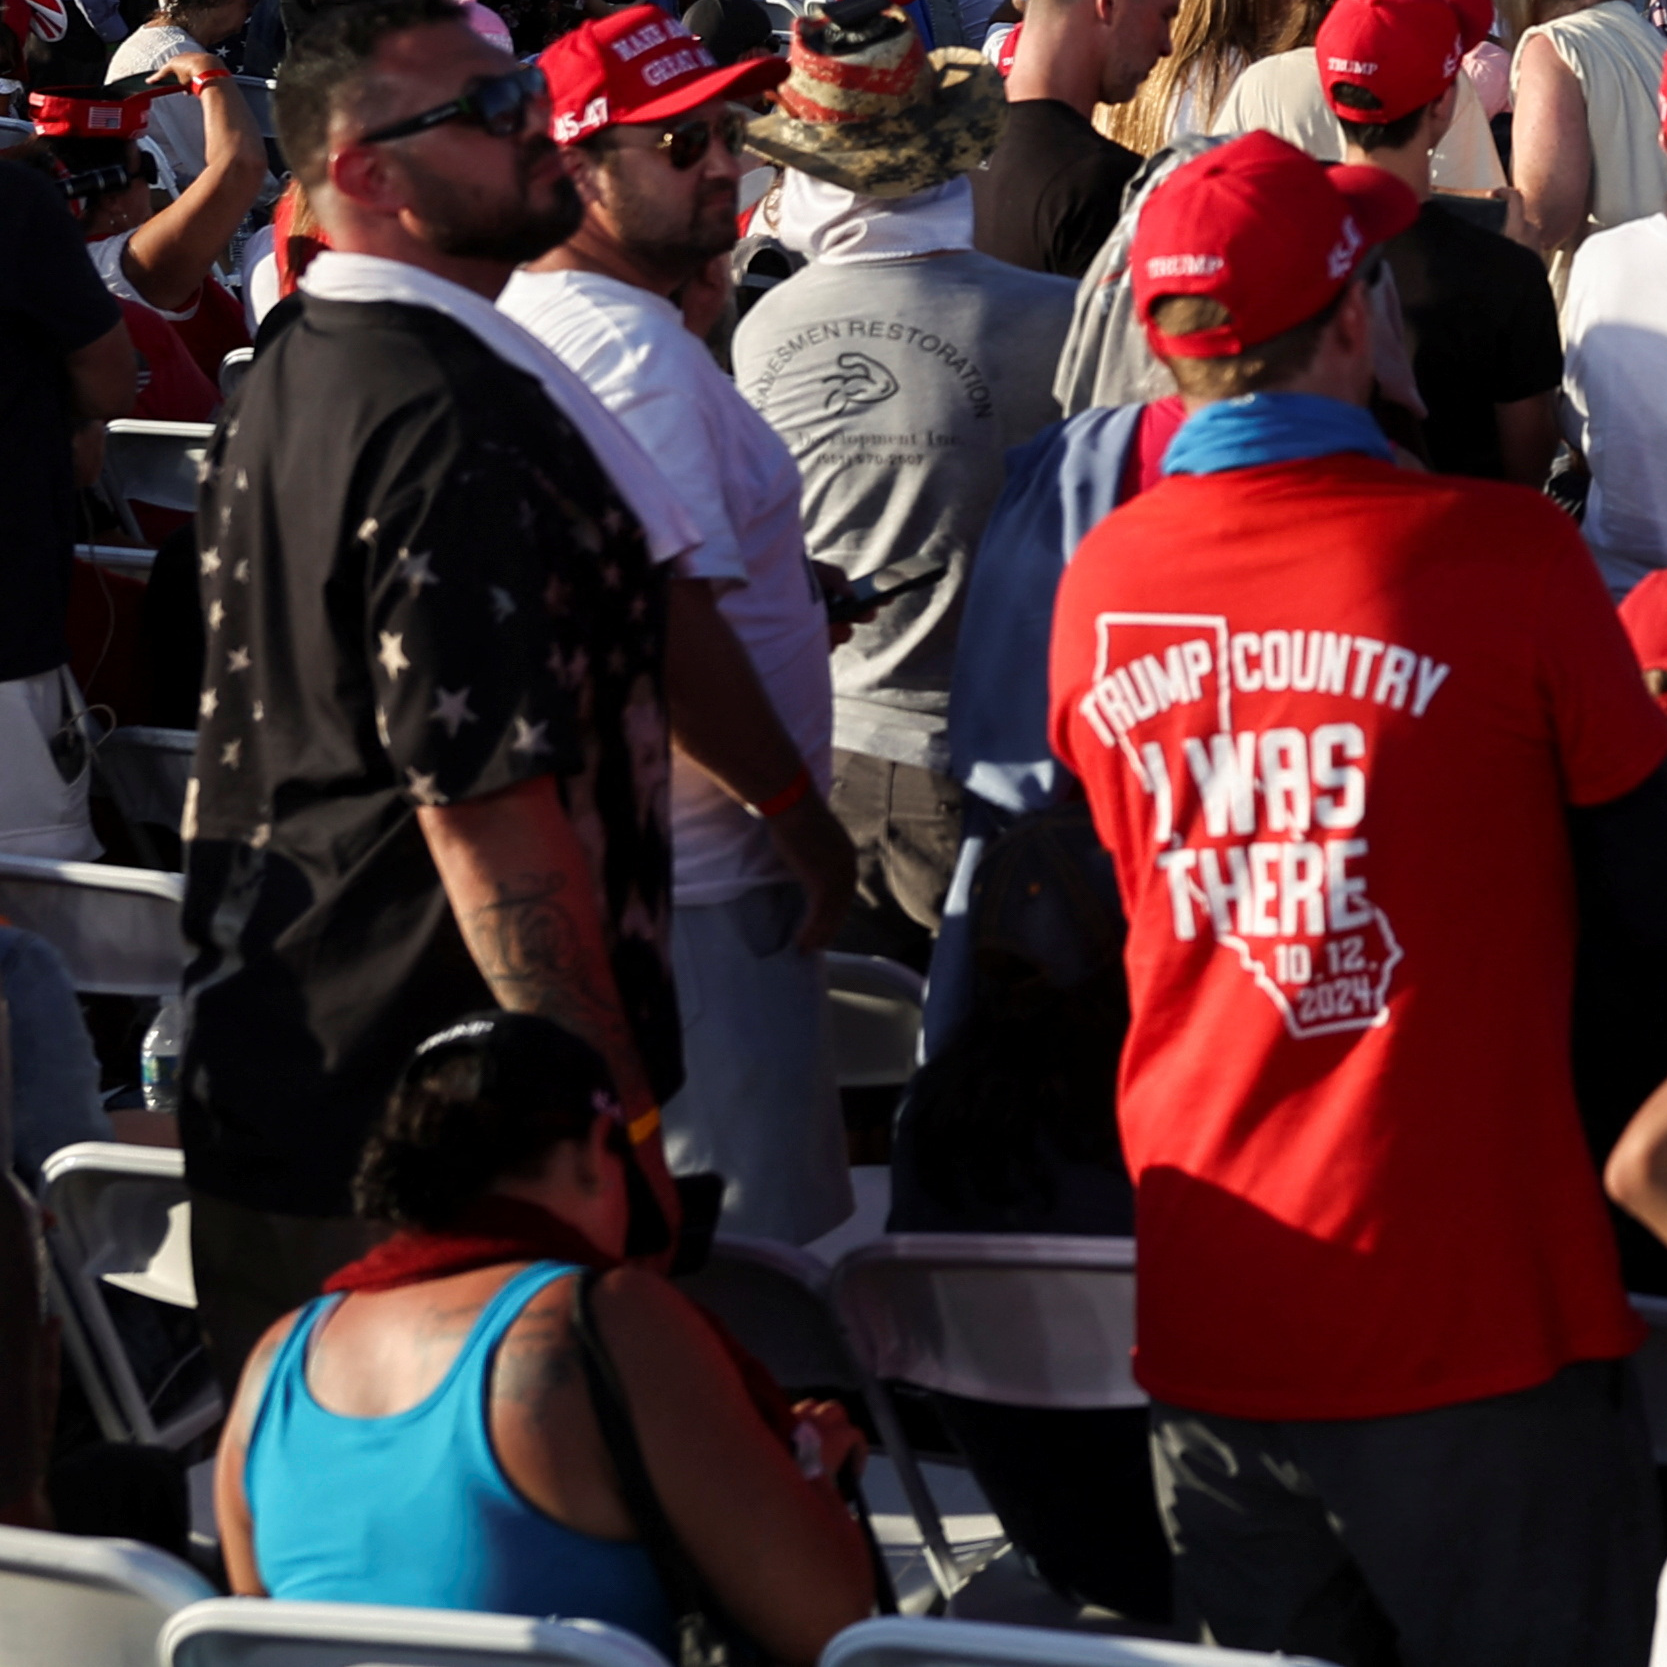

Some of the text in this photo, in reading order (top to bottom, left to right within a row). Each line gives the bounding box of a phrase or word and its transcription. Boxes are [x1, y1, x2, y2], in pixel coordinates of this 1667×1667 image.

[1327, 56, 1380, 74] TRUMP
[1147, 254, 1225, 279] TRUMP
[850, 320, 994, 420] RESTORATION
[1078, 630, 1451, 749] TRUMP COUNTRY
[1141, 723, 1367, 844] I WAS
[1157, 838, 1371, 941] THERE
[1296, 977, 1376, 1024] 2024
